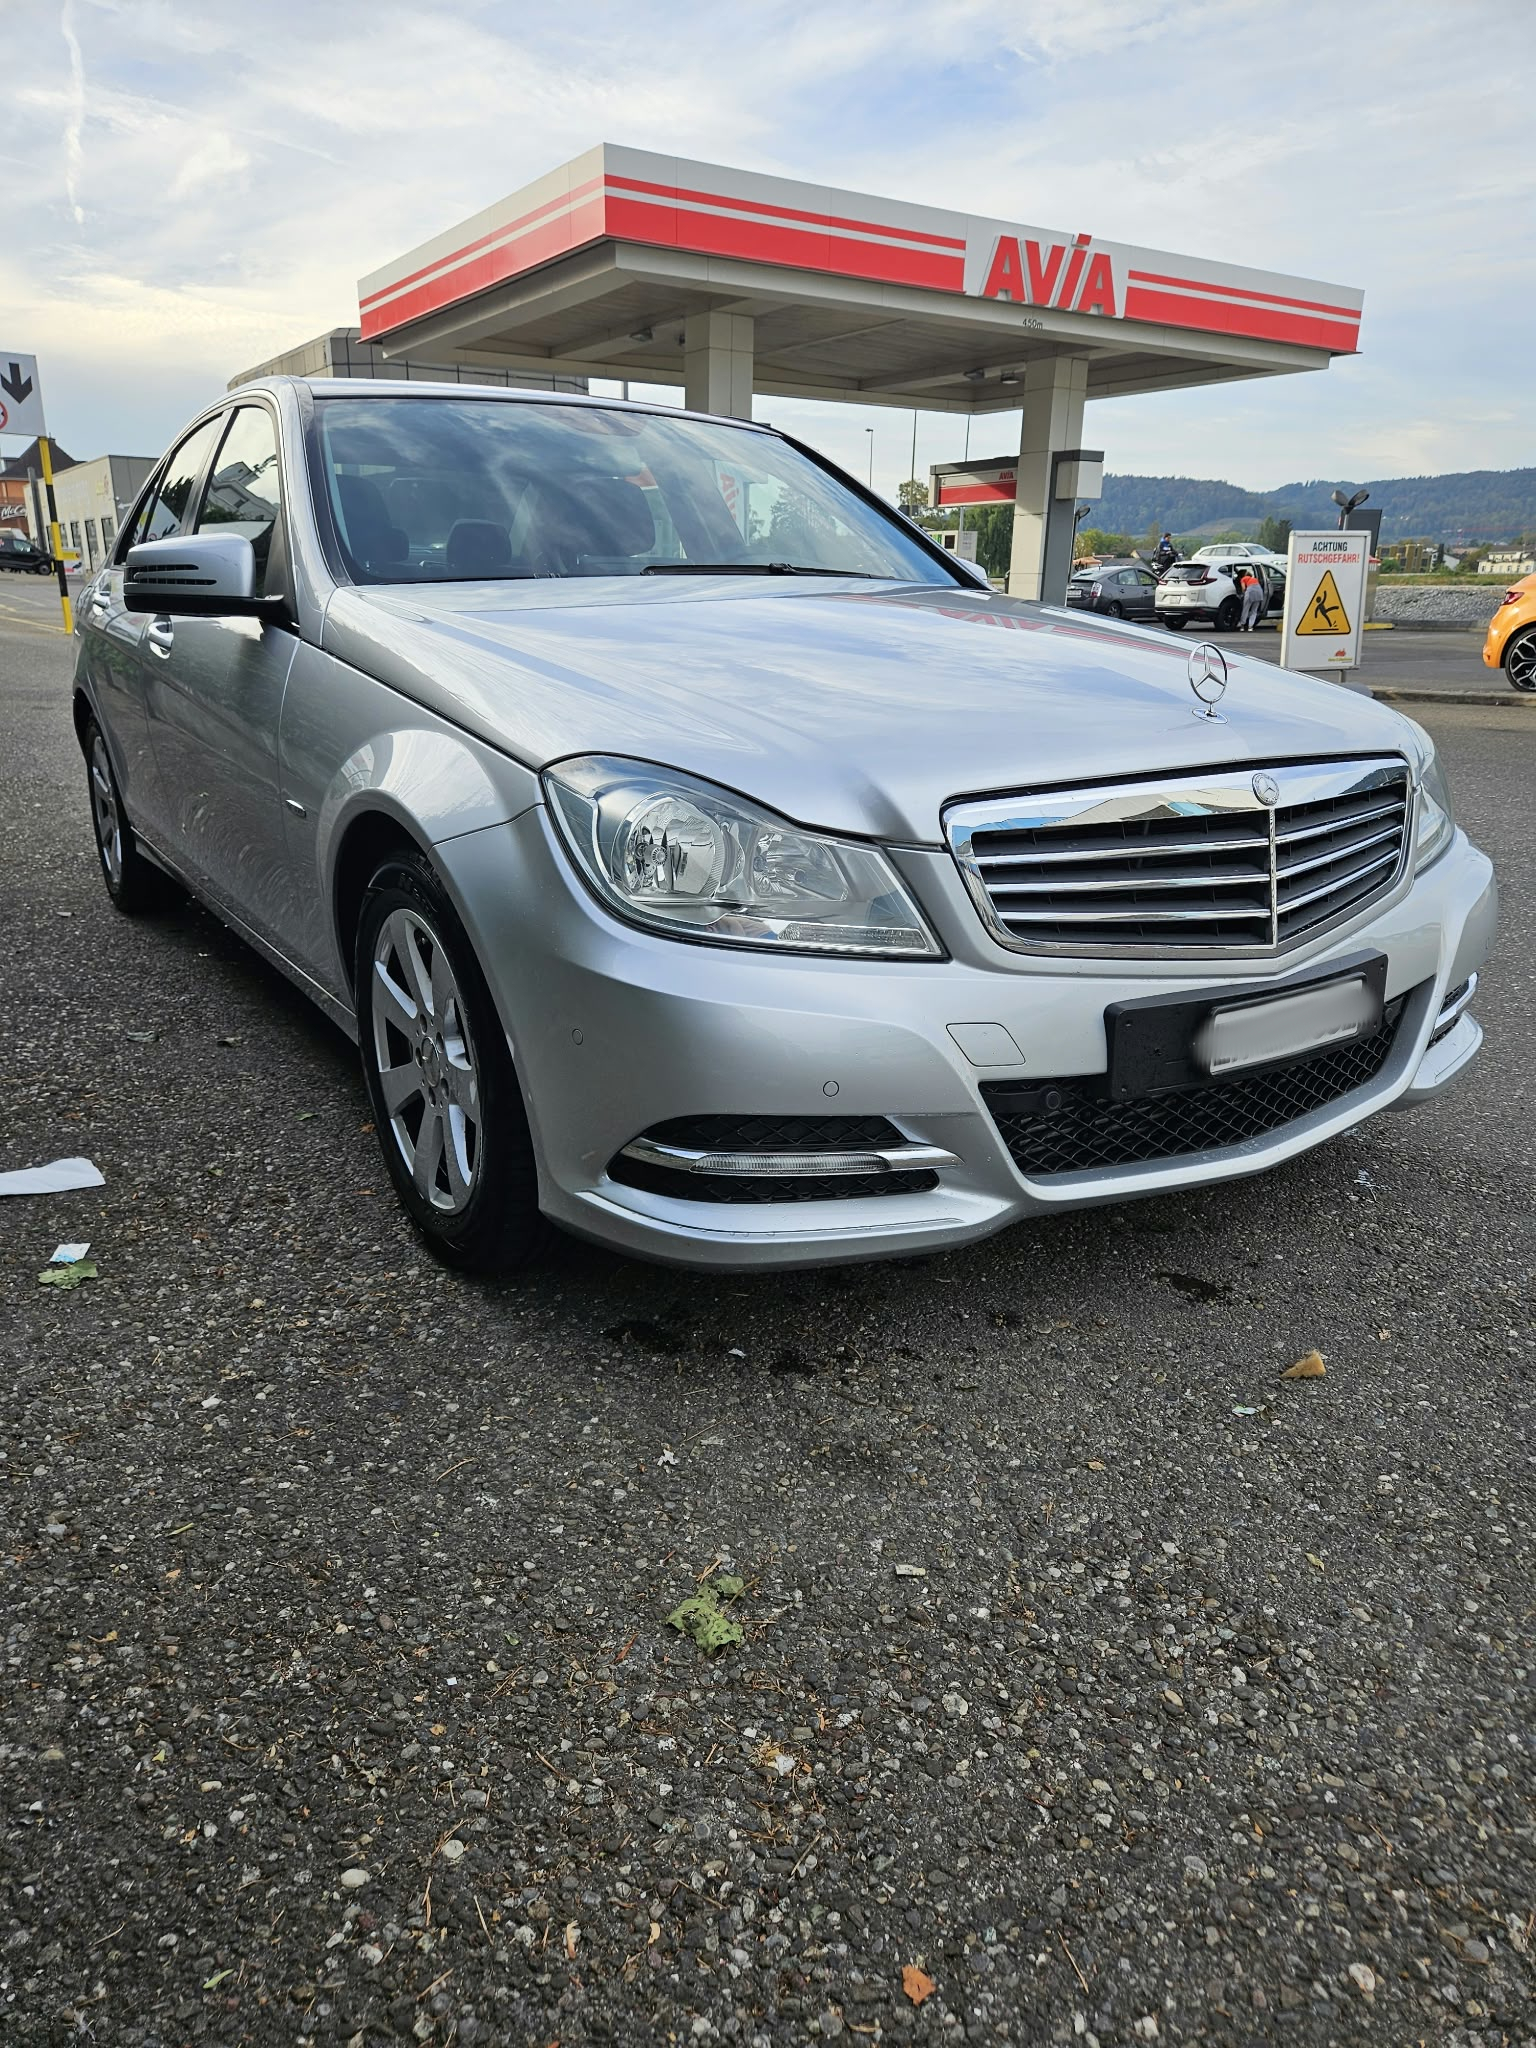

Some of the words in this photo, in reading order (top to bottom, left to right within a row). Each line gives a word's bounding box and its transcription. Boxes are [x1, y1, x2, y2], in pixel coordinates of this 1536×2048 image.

[983, 233, 1116, 316] AVIA
[999, 472, 1014, 480] AVIA
[1312, 541, 1348, 551] ACHTUNG
[1297, 553, 1360, 564] RUTSCHGEFAHR!
